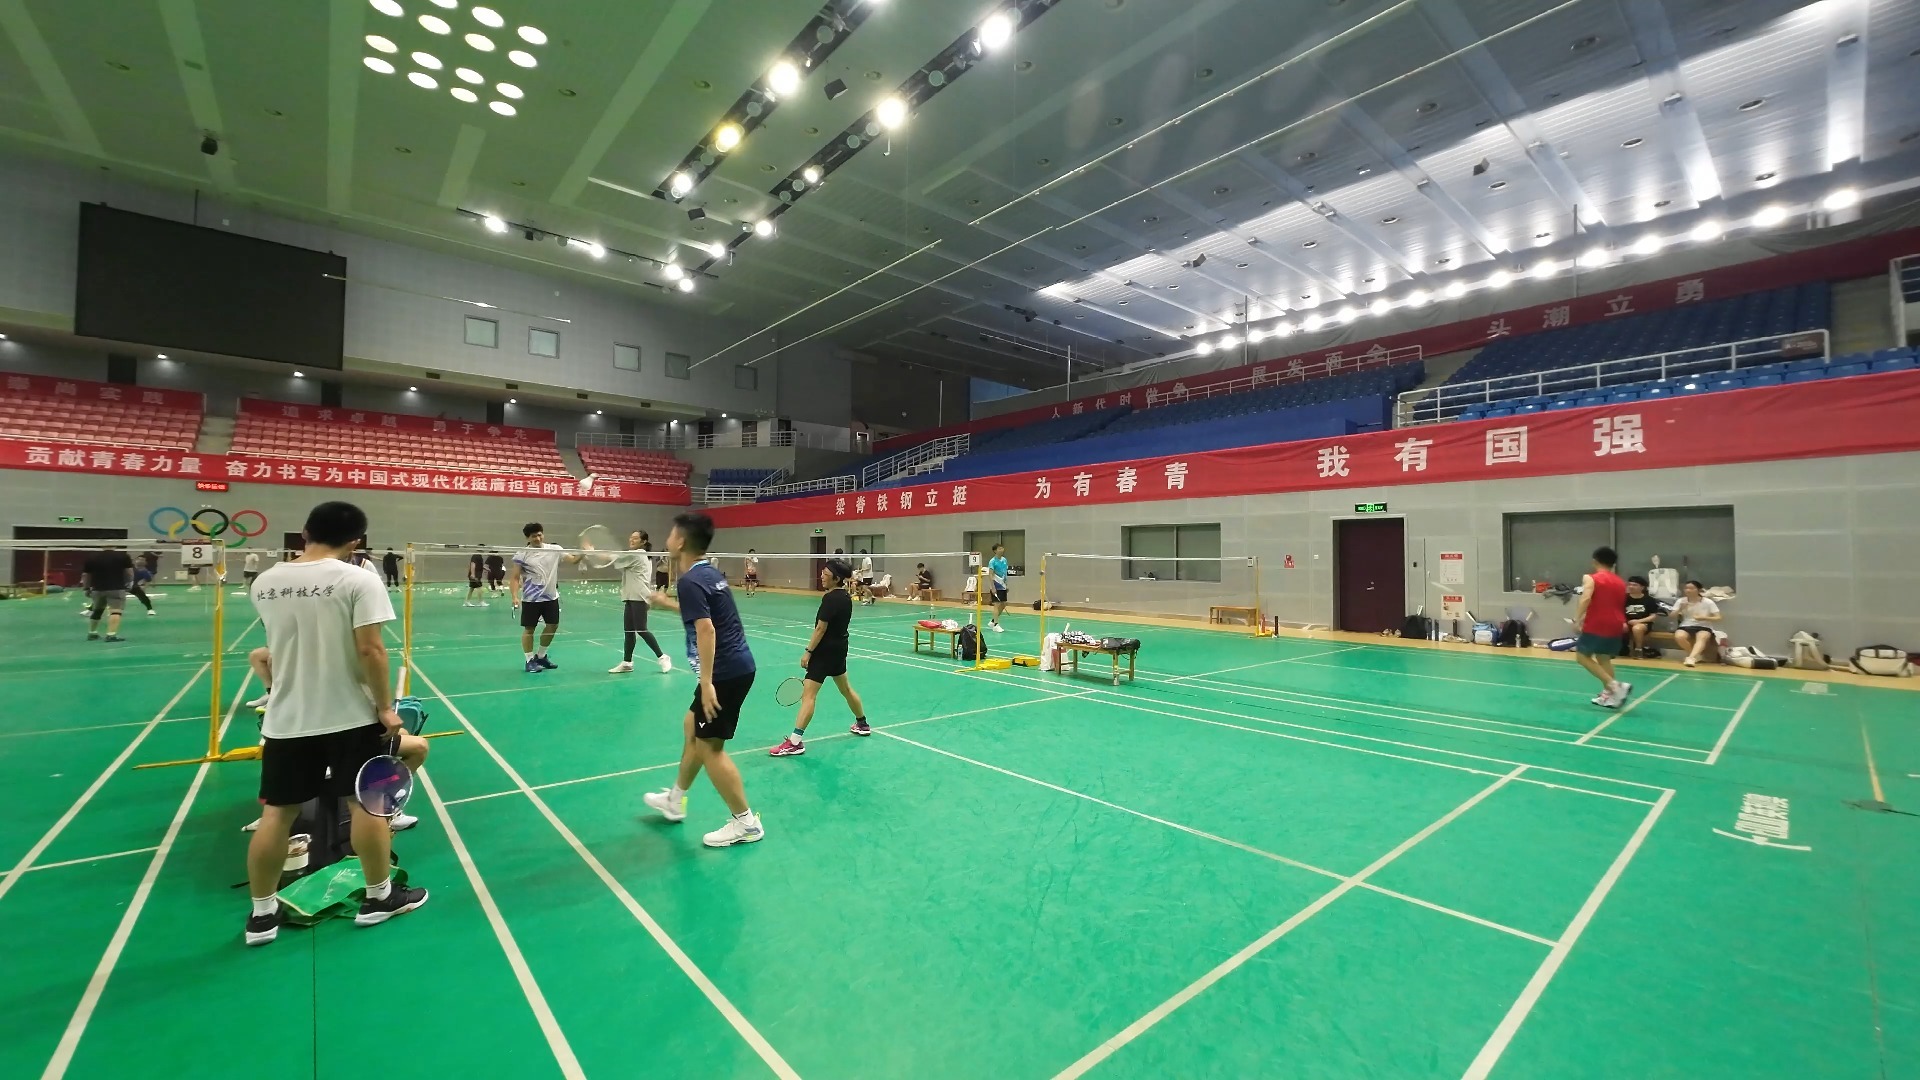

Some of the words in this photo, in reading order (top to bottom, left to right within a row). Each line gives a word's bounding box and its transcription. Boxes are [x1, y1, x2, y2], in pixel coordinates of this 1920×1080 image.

[25, 446, 201, 474] 贡献青春力量
[192, 546, 203, 559] 8
[257, 584, 335, 601] 北京科技大学
